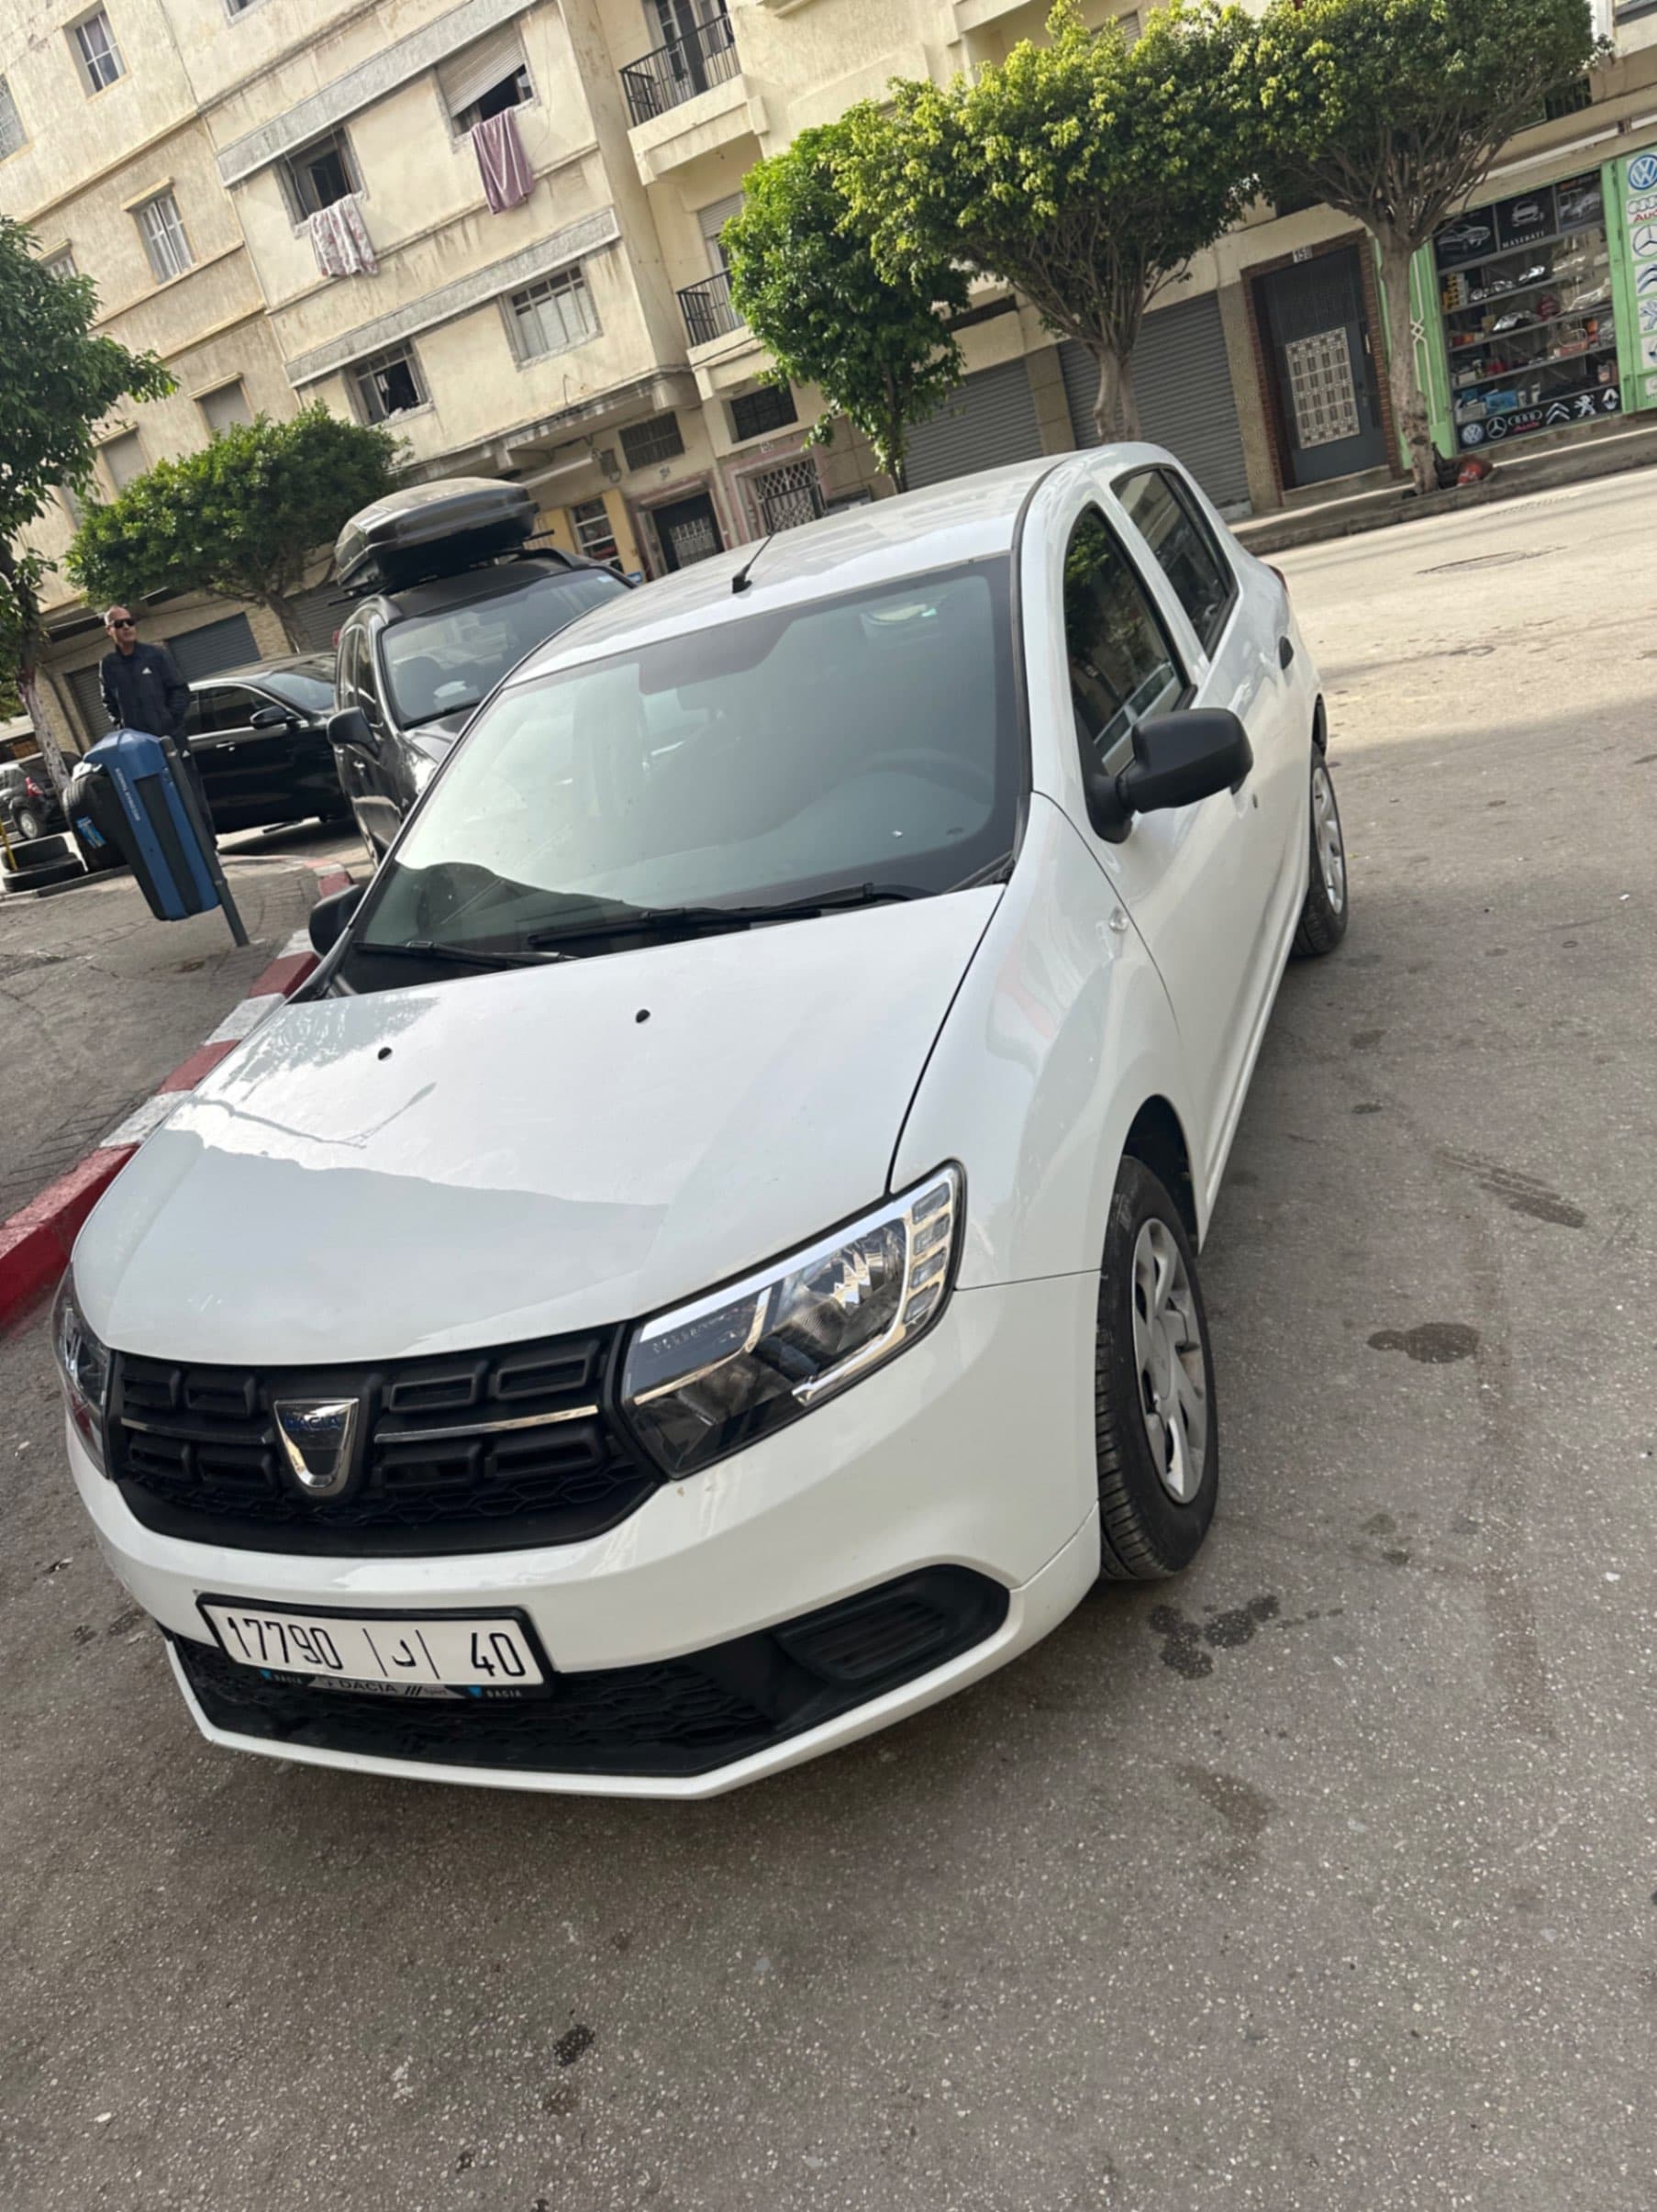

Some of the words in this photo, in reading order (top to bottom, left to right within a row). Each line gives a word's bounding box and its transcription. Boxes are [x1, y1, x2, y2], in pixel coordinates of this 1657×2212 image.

[1502, 230, 1545, 249] MASERATI
[227, 1617, 344, 1670] 17790
[471, 1632, 527, 1677] 40
[339, 1680, 397, 1694] DACIA
[486, 1688, 522, 1697] DACIA
